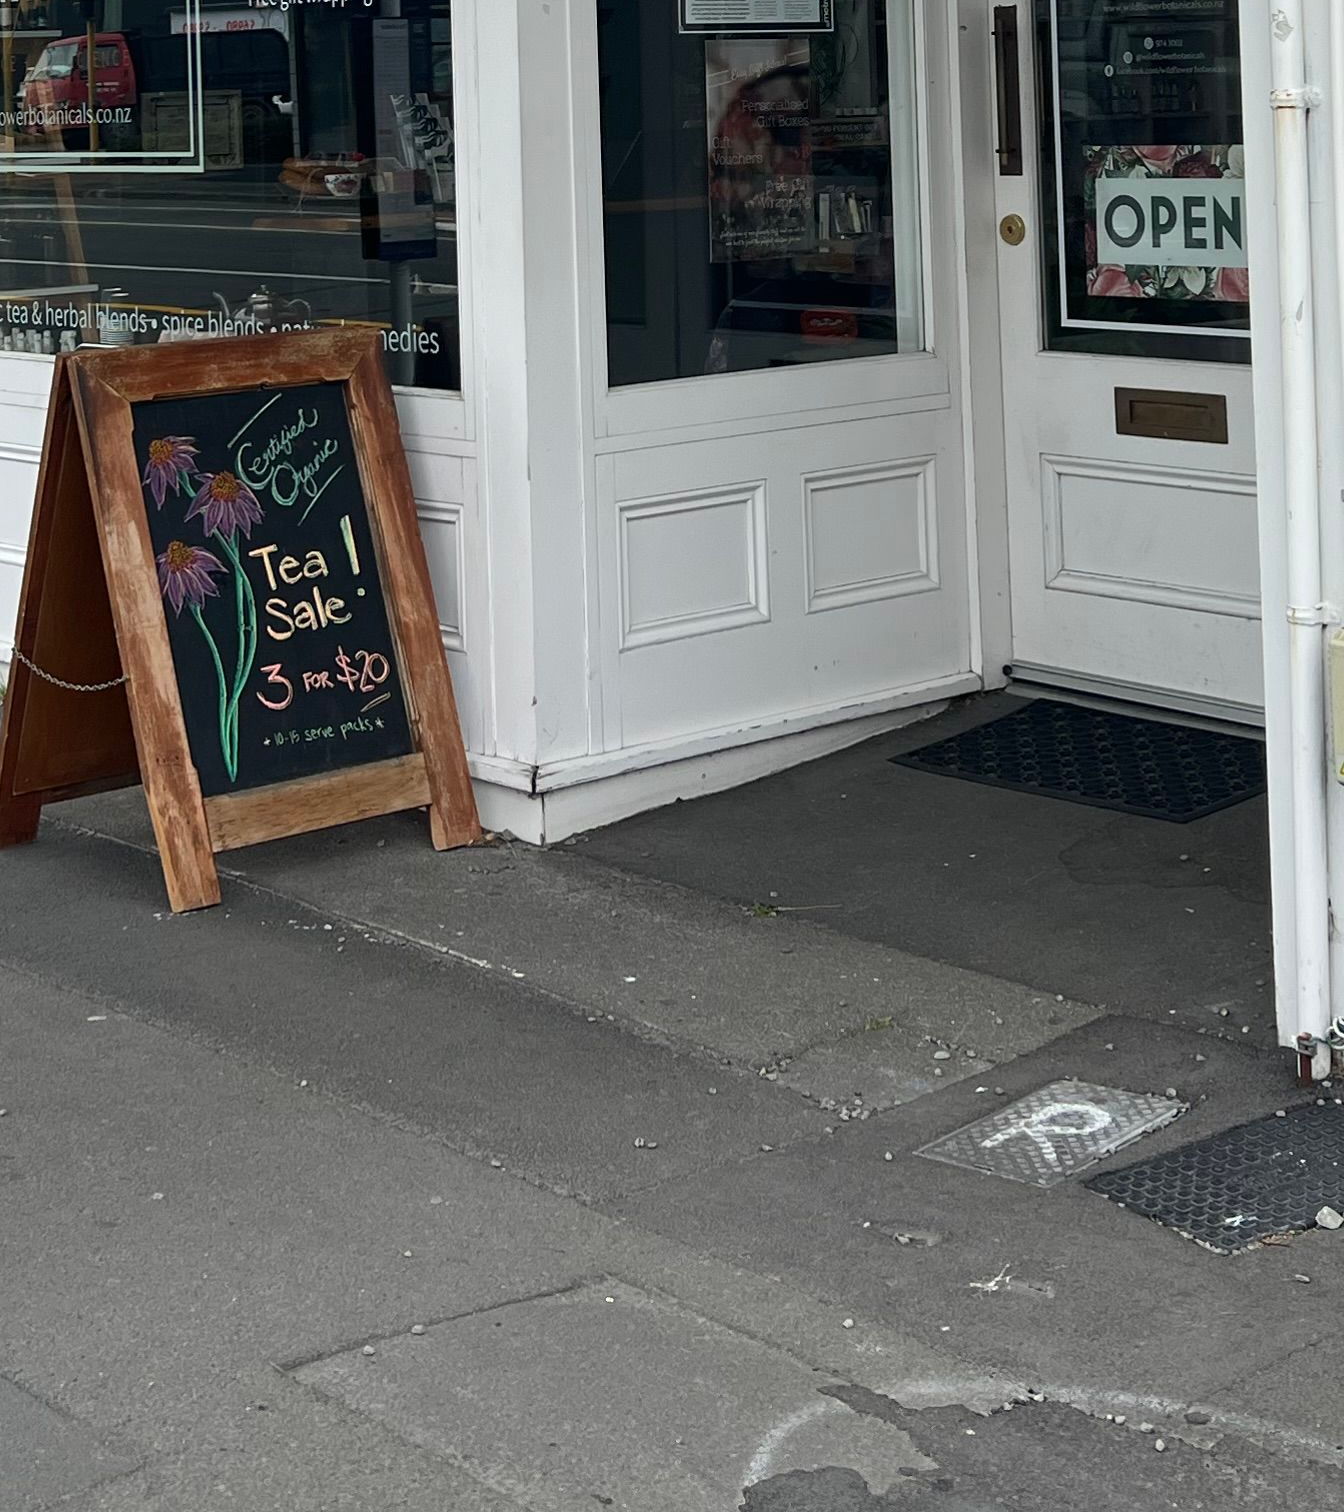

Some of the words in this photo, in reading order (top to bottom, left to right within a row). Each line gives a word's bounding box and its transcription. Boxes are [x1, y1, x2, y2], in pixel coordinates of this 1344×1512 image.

[712, 152, 763, 167] Vouchers
[1103, 193, 1242, 251] OPEN
[7, 302, 29, 324] tea
[32, 304, 43, 325] &
[46, 300, 93, 329] herbal
[96, 303, 146, 333] blends
[162, 309, 204, 338] spice
[207, 310, 264, 337] blends
[235, 407, 319, 490] Certified
[271, 439, 339, 506] Organic
[248, 543, 329, 591] Tea
[264, 586, 353, 640] Sale
[256, 663, 294, 711] 3
[302, 671, 335, 693] FOR
[334, 645, 390, 693] $20
[304, 726, 335, 742] serve
[340, 717, 374, 740] packs
